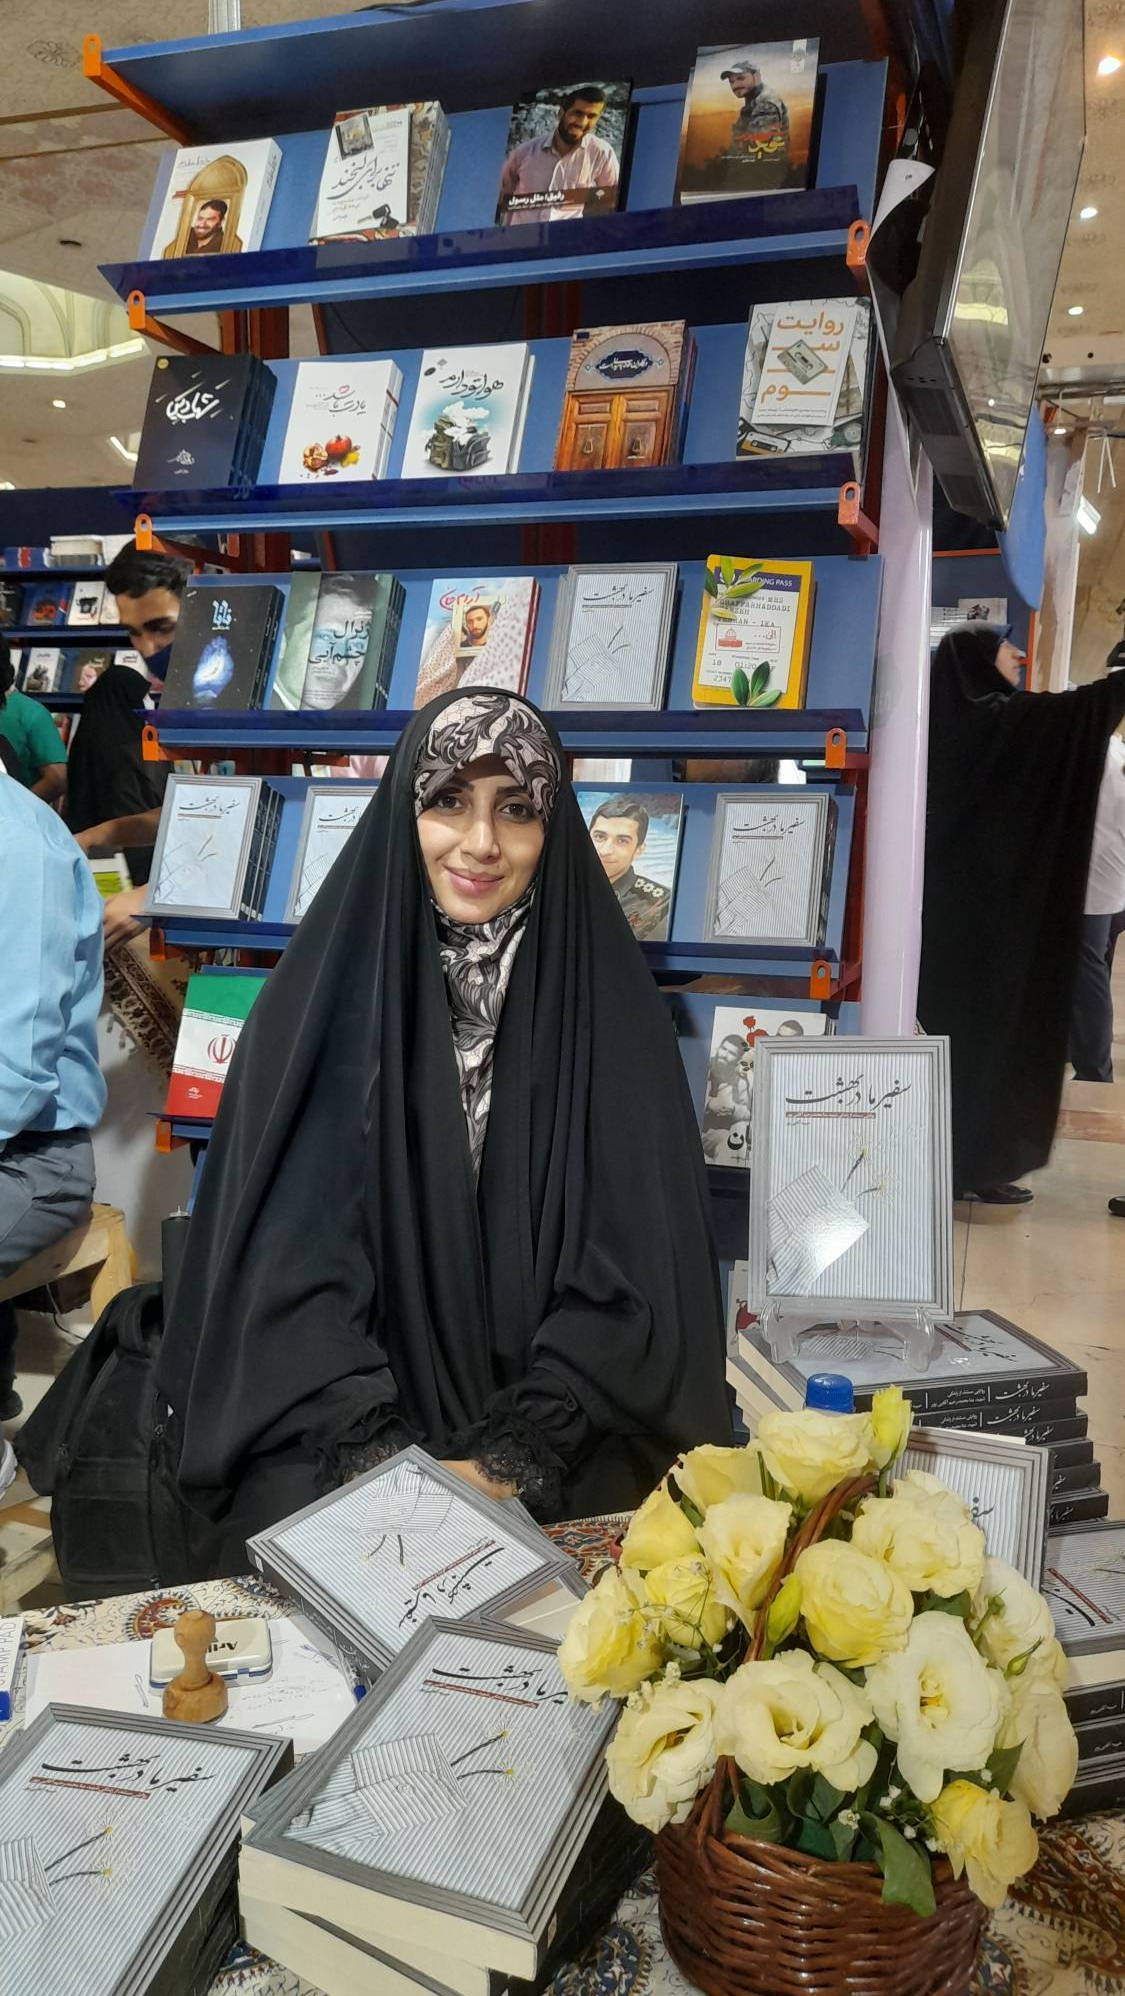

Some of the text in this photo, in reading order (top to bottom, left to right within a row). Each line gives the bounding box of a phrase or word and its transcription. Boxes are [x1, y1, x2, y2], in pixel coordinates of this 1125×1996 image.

[508, 196, 529, 206] رسول
[776, 311, 845, 336] روایت
[776, 579, 793, 587] PASS
[333, 619, 371, 640] ژنرال
[785, 1073, 864, 1105] بهشت
[869, 1080, 911, 1111] سفیر
[845, 1091, 861, 1107] در
[995, 1381, 1029, 1399] بهشت
[1033, 1382, 1050, 1399] سفیر
[986, 1405, 1020, 1424] بهشت
[1023, 1407, 1041, 1424] سفیر
[1036, 1425, 1055, 1443] سفیر
[398, 1590, 421, 1628] سفیر
[448, 1547, 505, 1605] بهشت
[431, 1665, 543, 1688] بهشت
[536, 1680, 548, 1696] ما
[41, 1753, 160, 1779] بهشت
[115, 1769, 144, 1782] در
[146, 1767, 216, 1793] سفیر
